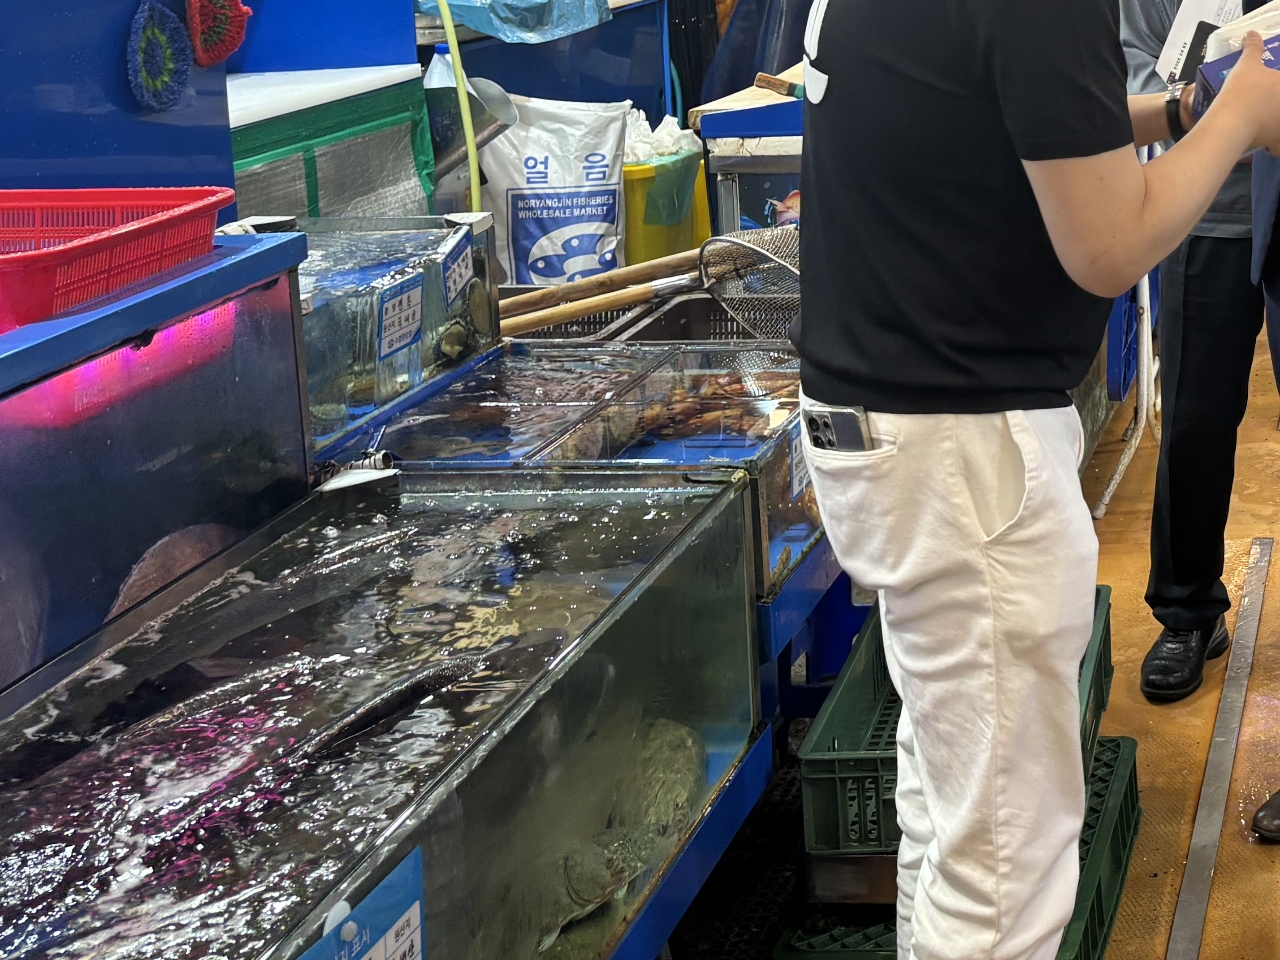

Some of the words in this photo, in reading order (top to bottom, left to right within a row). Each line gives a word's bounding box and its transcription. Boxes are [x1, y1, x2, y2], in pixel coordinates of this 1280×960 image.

[518, 195, 572, 209] NORYANGJIN
[573, 194, 613, 206] FISHERIES
[518, 208, 572, 219] WHOLESALE
[573, 206, 608, 217] MARKET
